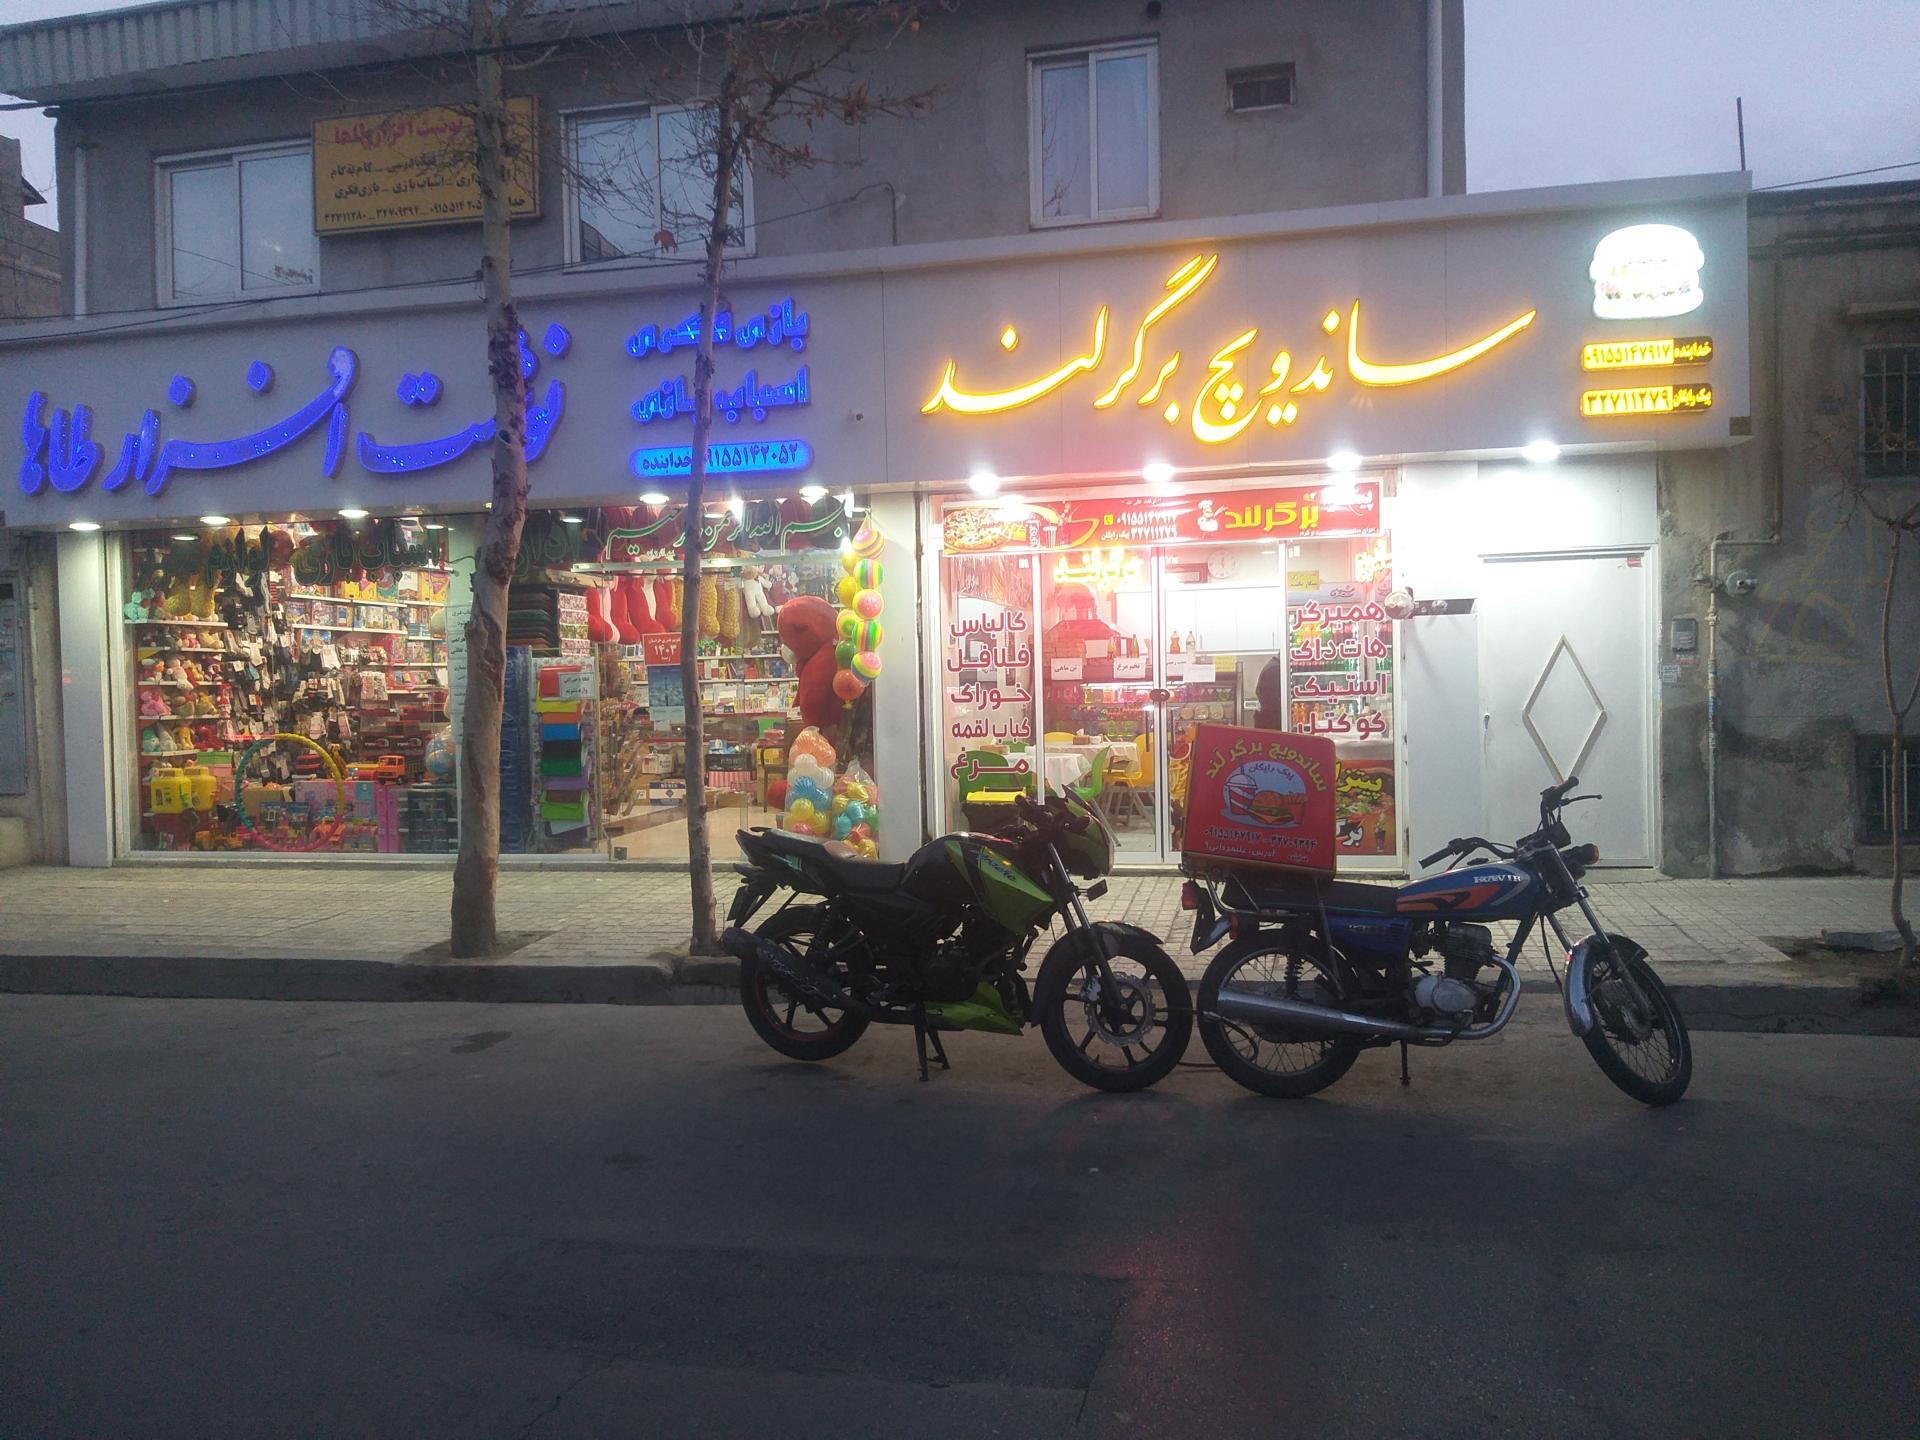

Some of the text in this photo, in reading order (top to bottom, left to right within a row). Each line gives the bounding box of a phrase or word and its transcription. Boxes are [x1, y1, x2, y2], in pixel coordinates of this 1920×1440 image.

[1191, 297, 1538, 444] ساندویچ
[949, 611, 1028, 638] کالباس
[946, 644, 1031, 672] فلافل
[1293, 672, 1387, 704] استیک
[952, 717, 1031, 743] کباب لقمه
[950, 746, 1030, 780] مرغ
